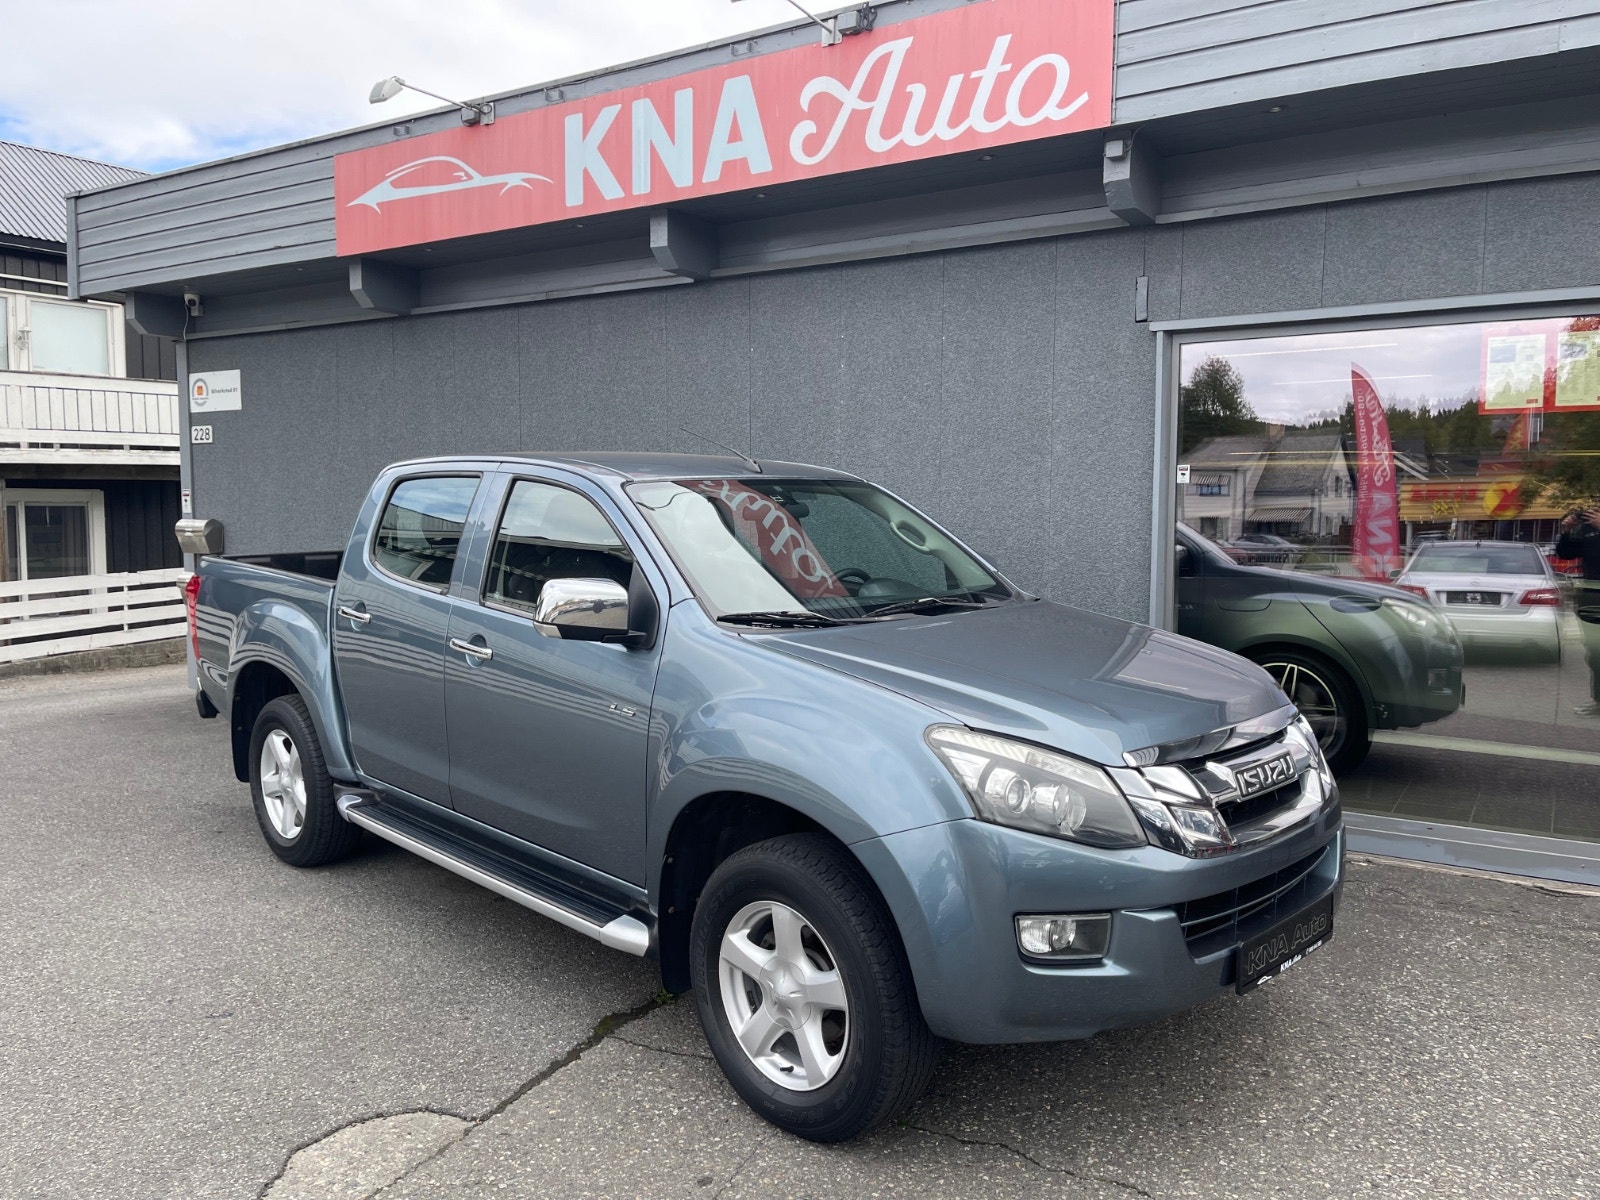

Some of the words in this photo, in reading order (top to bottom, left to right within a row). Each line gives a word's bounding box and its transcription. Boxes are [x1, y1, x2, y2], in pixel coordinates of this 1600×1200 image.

[564, 75, 773, 207] KNA
[789, 34, 1090, 166] Auto
[193, 428, 211, 441] 228
[1237, 755, 1294, 795] ISUZU
[1247, 933, 1289, 975] KNA
[1290, 912, 1327, 950] Auto
